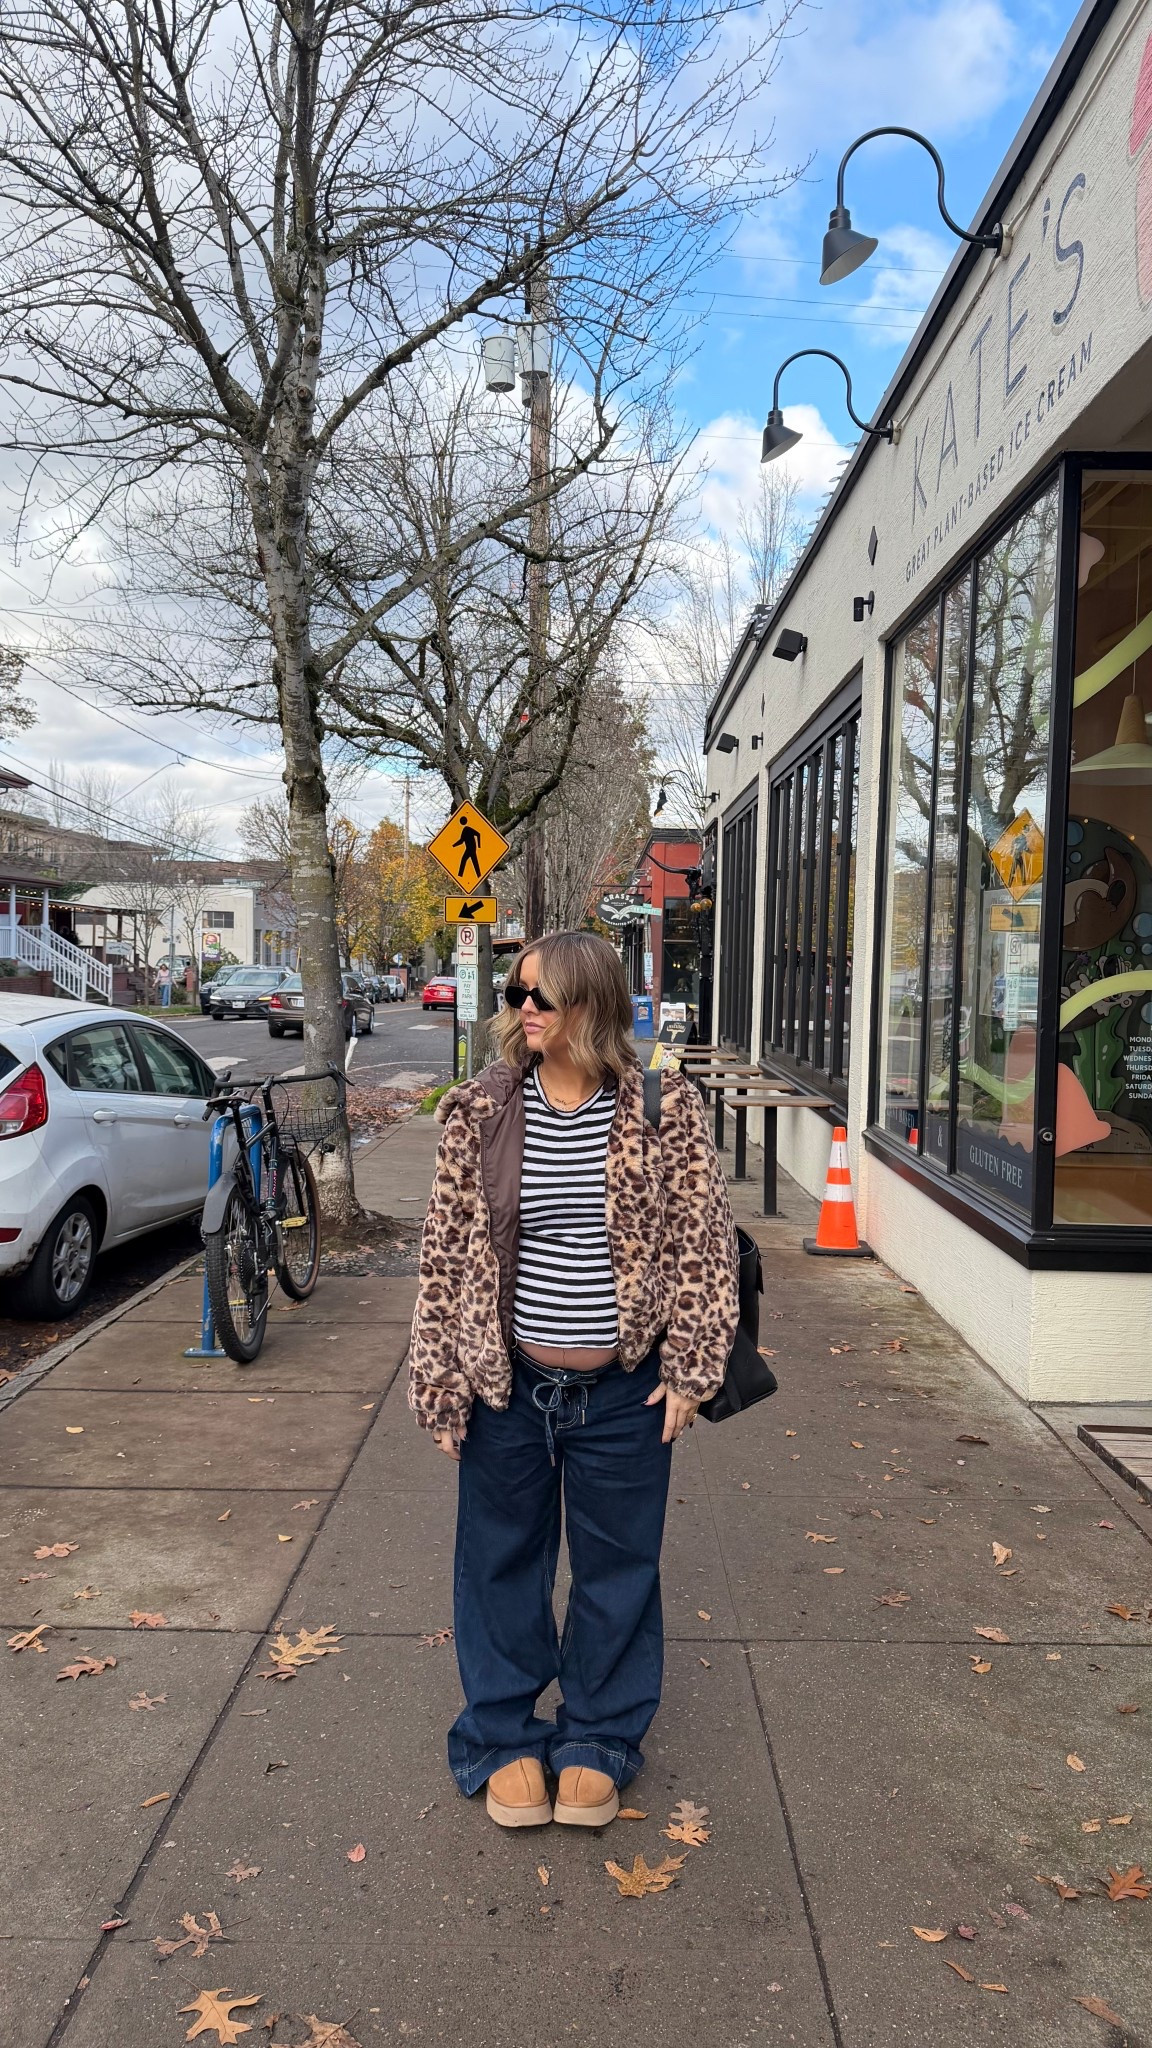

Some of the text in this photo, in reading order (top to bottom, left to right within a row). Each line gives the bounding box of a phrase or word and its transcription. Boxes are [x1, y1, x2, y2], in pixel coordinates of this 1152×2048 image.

[911, 172, 1087, 528] KATE'S
[905, 331, 1093, 583] GREAT PLANT-BASED ICE CREAM
[937, 1125, 943, 1147] &
[969, 1144, 1023, 1189] GLUTEN FREE
